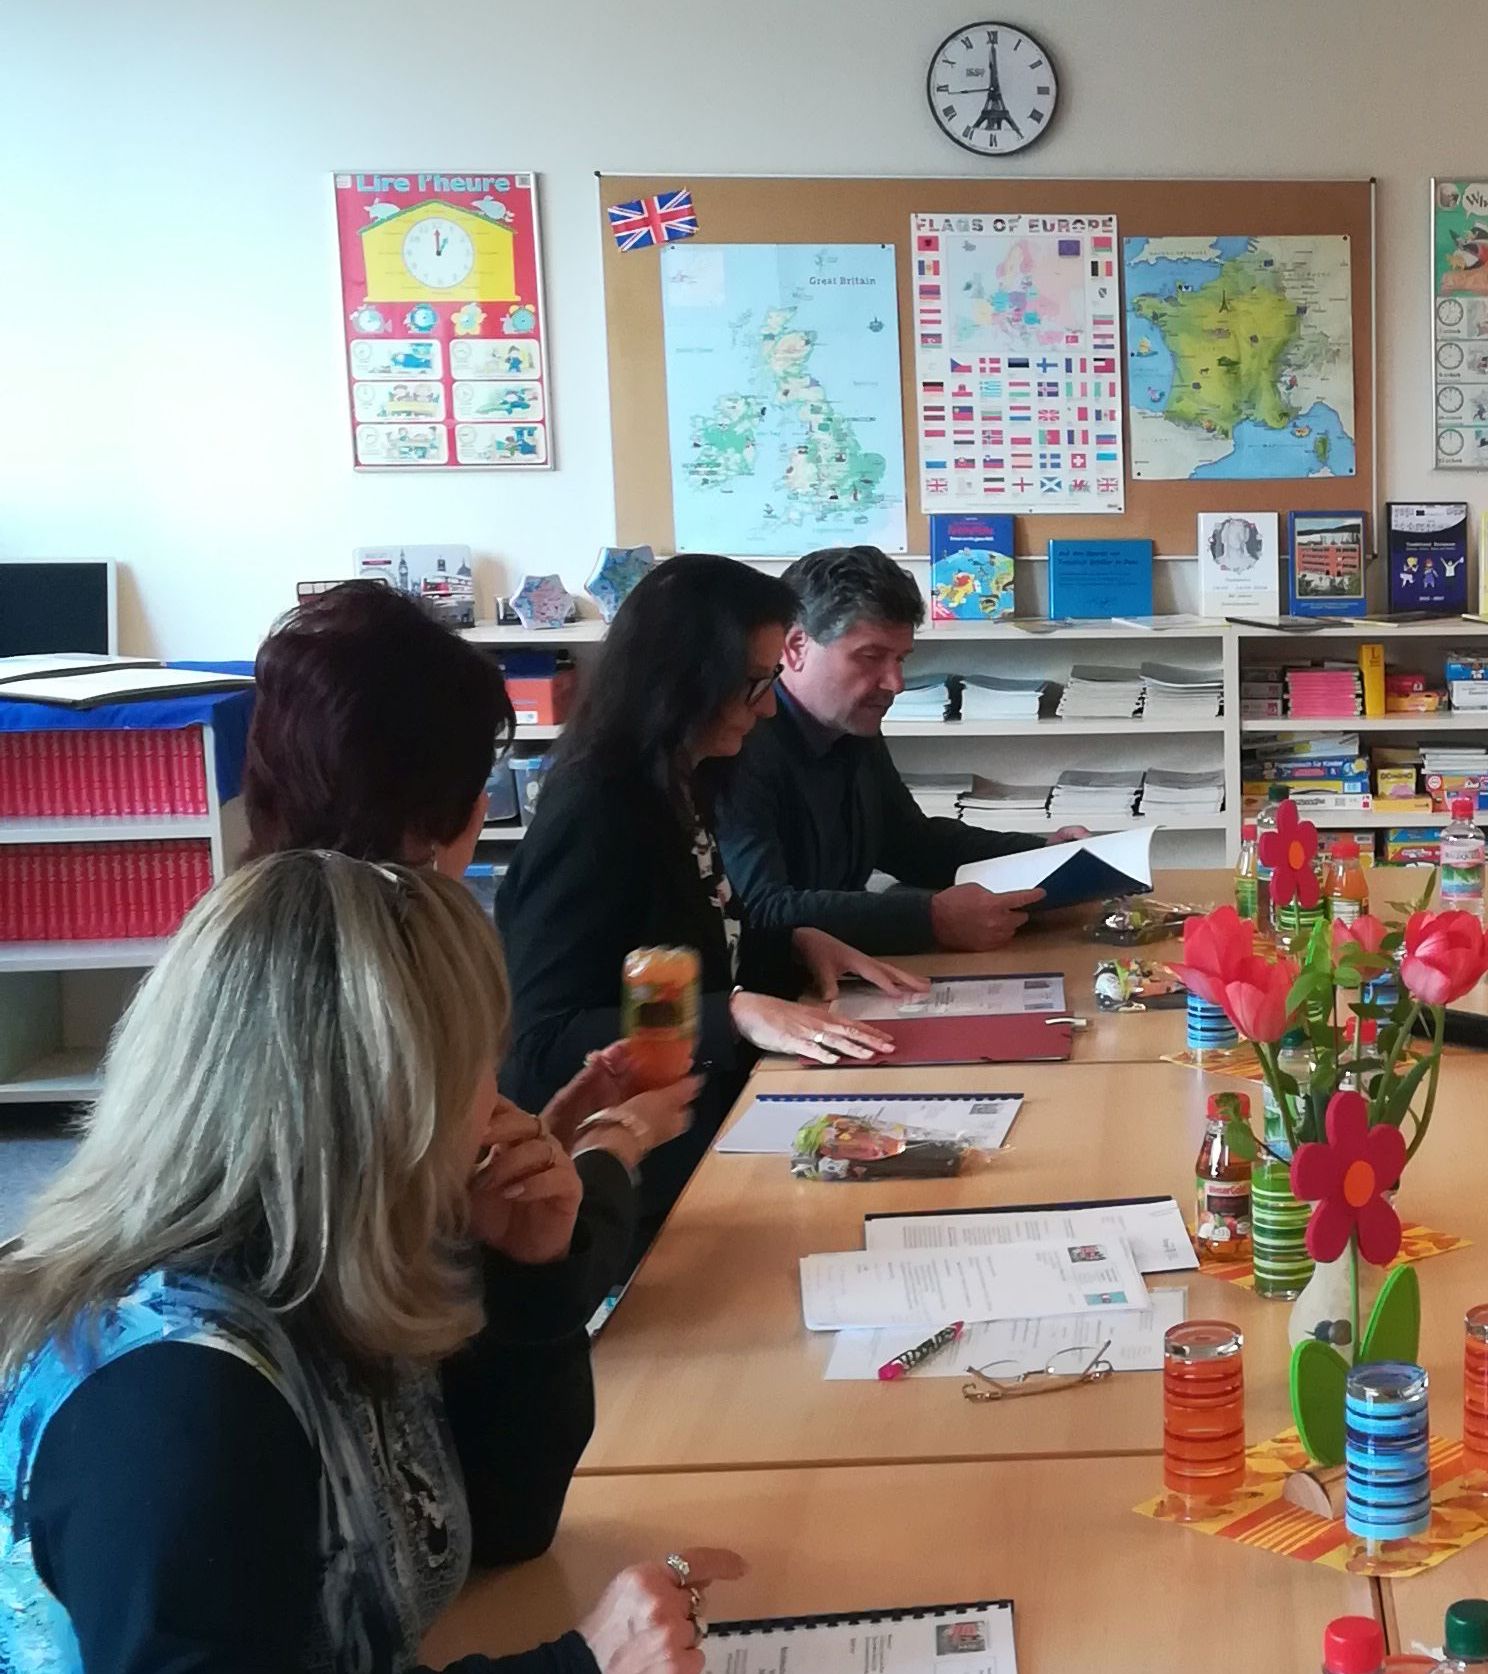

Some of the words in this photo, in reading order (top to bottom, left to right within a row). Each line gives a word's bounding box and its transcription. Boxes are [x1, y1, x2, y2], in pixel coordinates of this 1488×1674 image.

[357, 175, 410, 192] Lire
[418, 174, 511, 192] l'heure
[915, 218, 984, 232] FLAGS
[993, 218, 1020, 232] OF
[1028, 219, 1113, 232] EUROPE
[809, 276, 838, 286] Great
[839, 275, 877, 286] Britain
